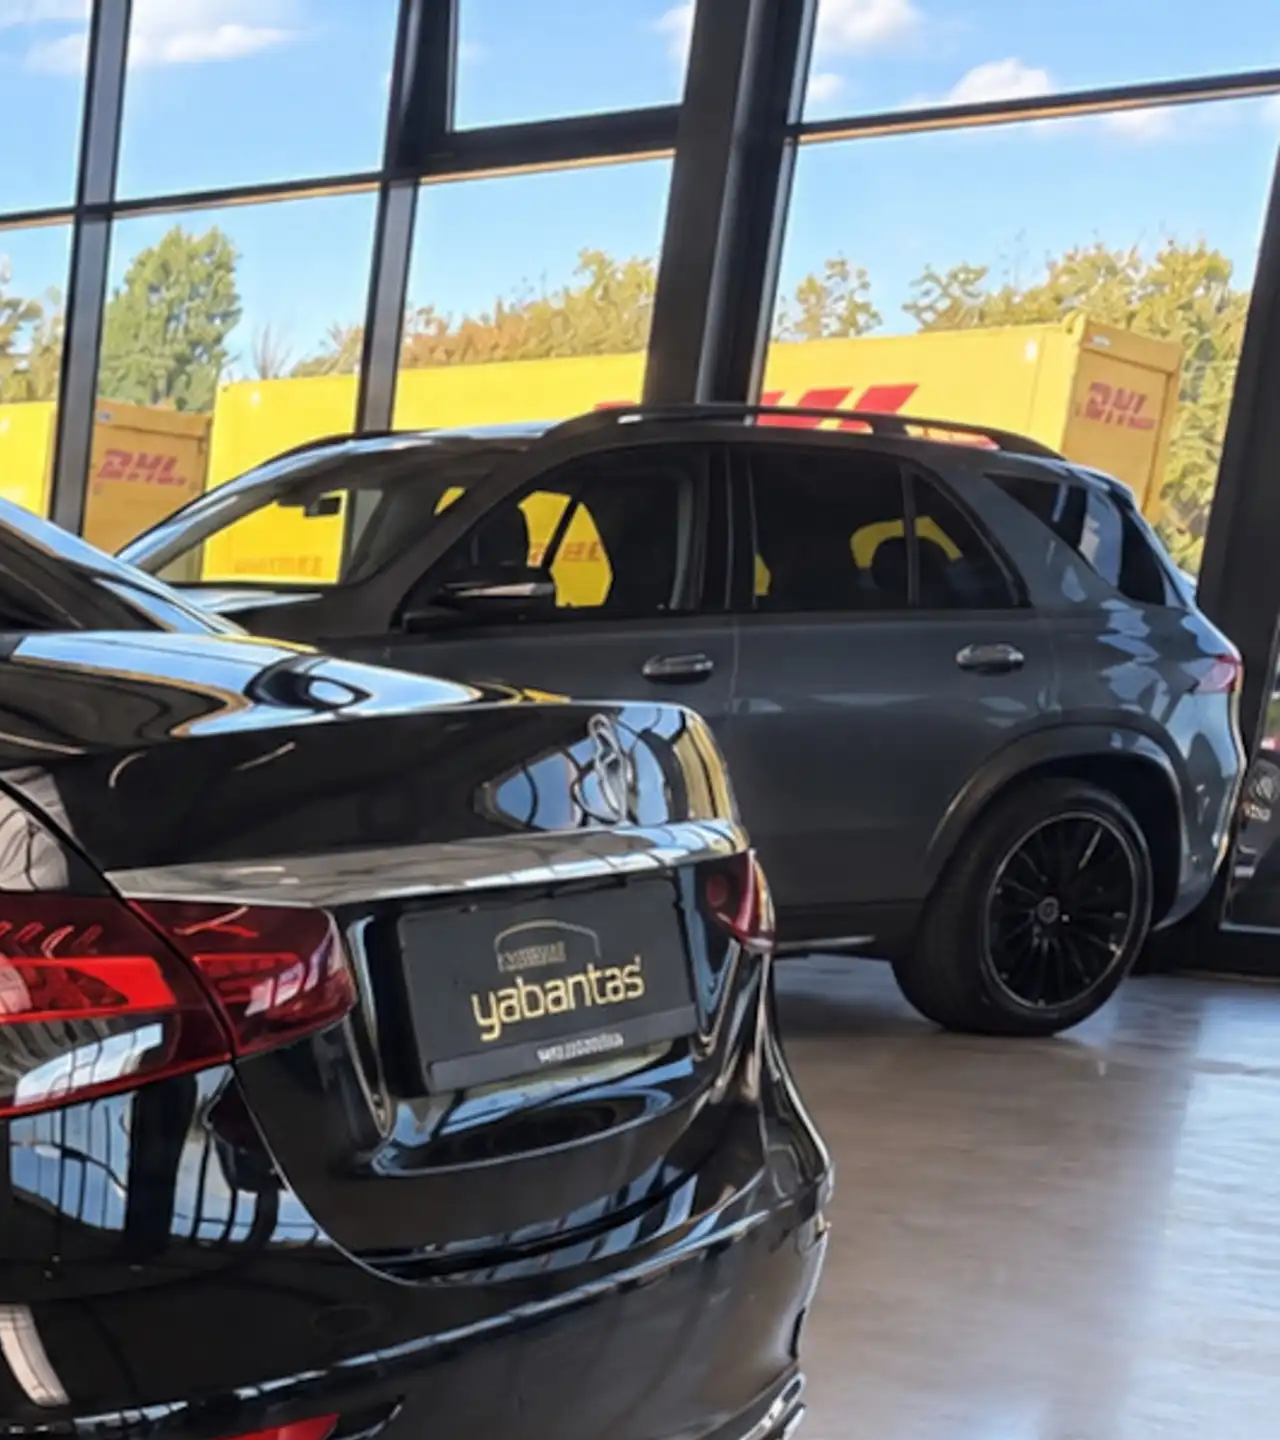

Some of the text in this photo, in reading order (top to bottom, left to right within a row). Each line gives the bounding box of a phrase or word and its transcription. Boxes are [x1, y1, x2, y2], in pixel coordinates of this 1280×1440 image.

[1085, 382, 1156, 430] DHL
[97, 448, 187, 485] DHL
[471, 956, 645, 1042] yabantas
